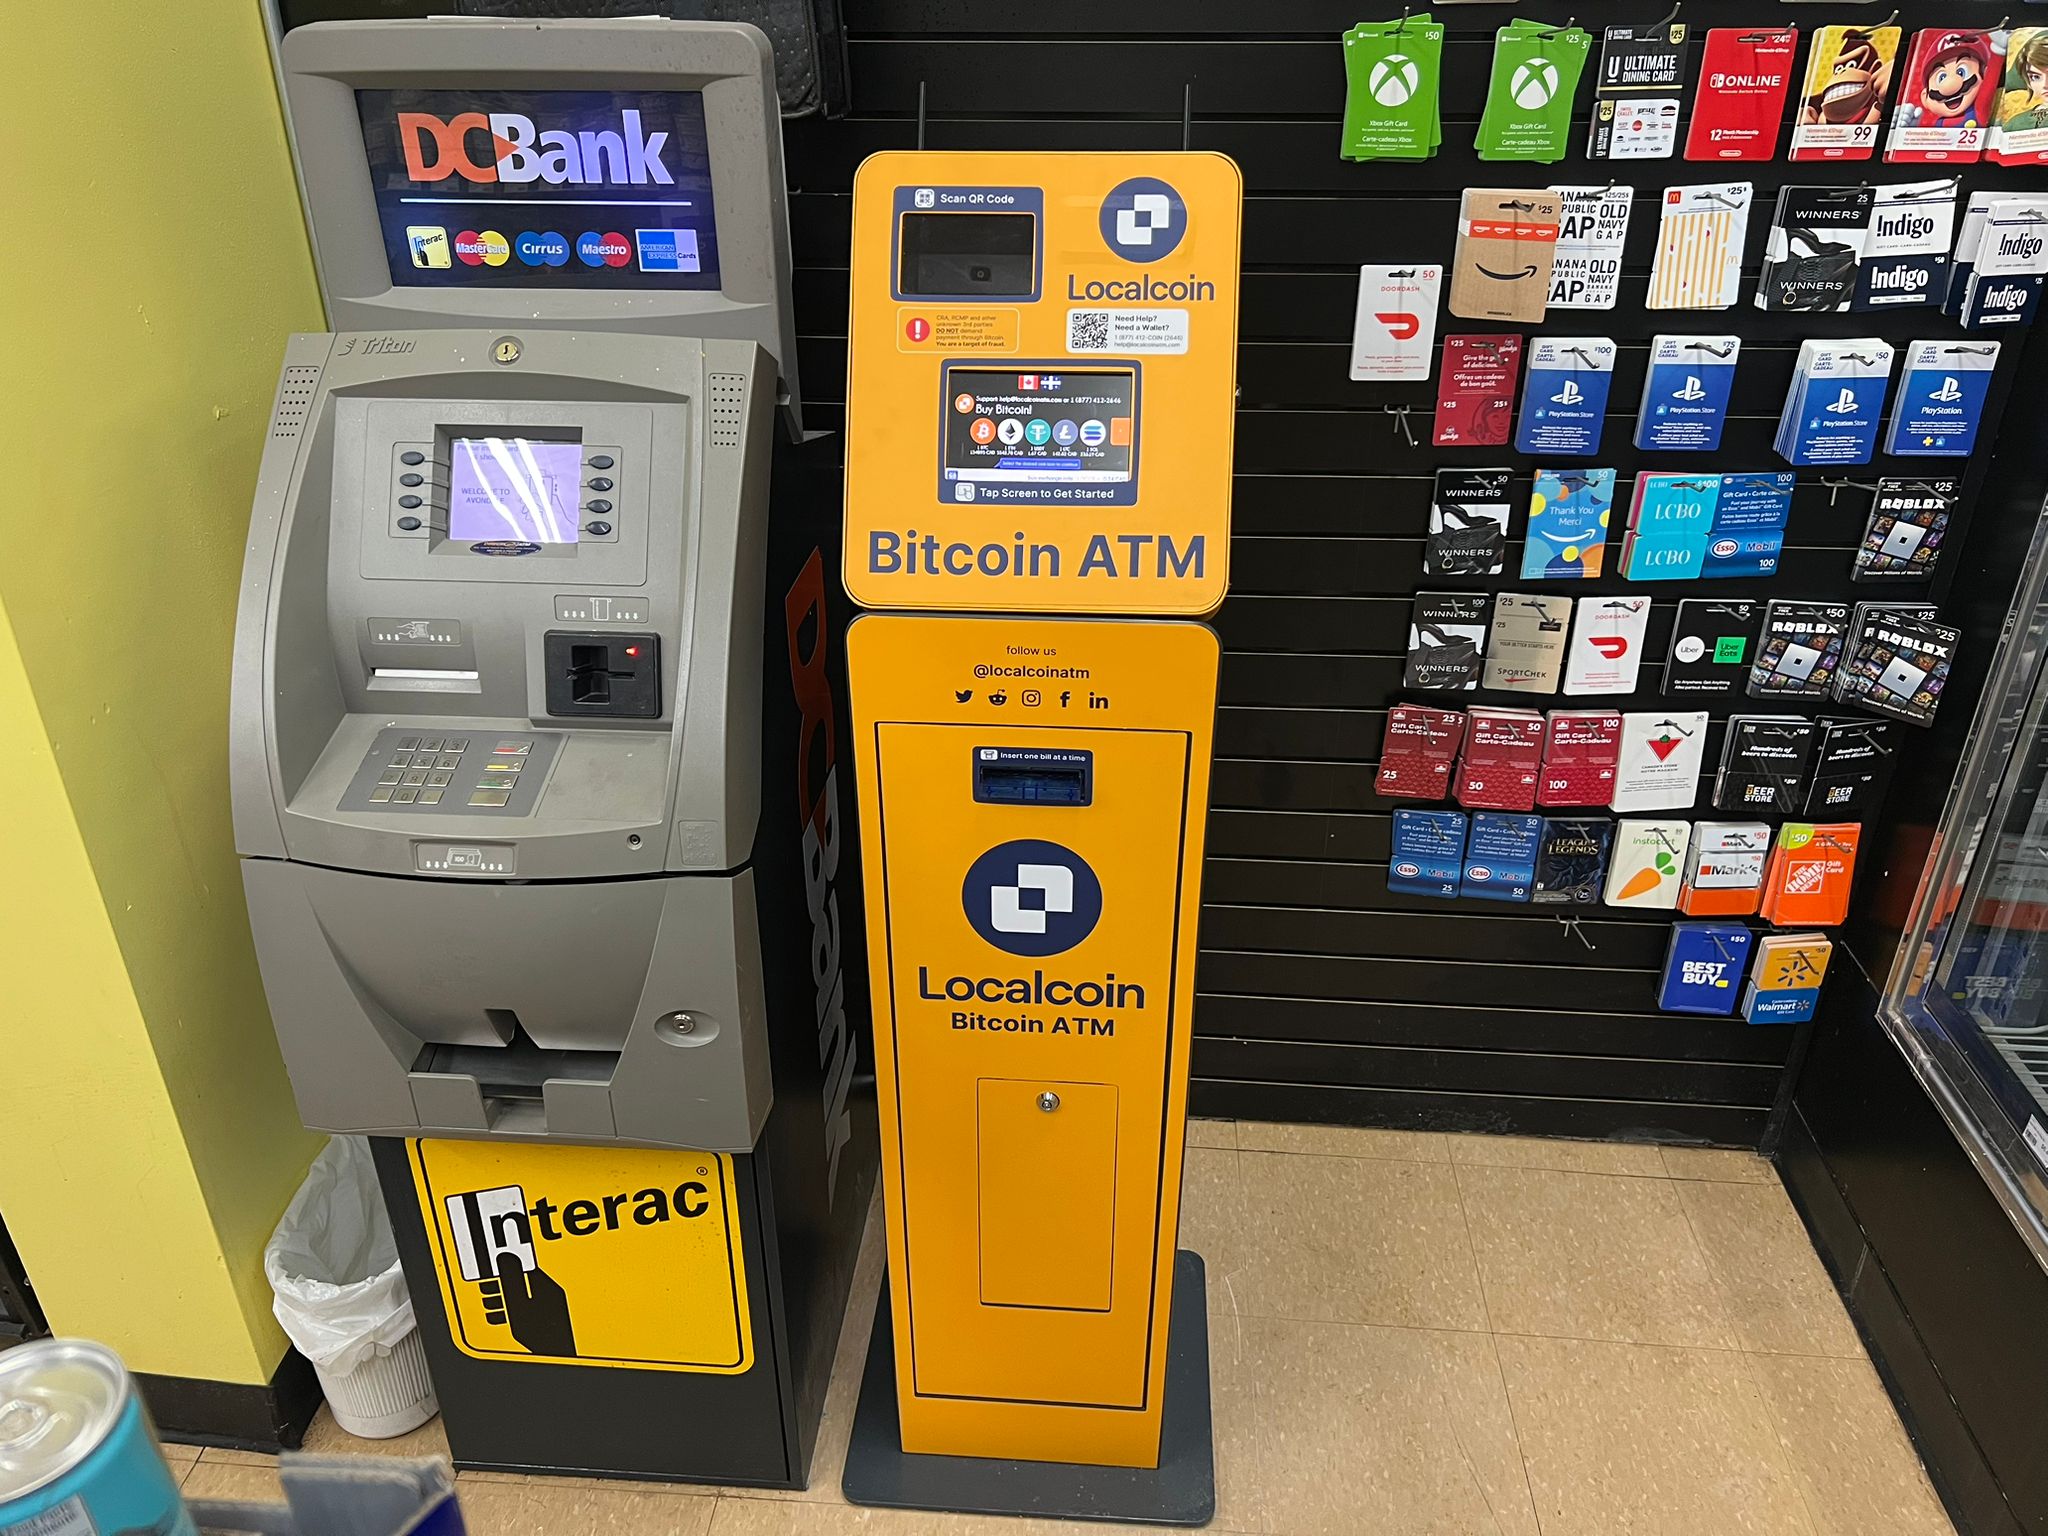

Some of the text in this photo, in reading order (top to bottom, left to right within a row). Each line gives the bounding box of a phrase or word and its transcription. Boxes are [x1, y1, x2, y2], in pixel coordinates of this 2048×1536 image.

[1425, 31, 1440, 40] $50
[1566, 34, 1580, 44] $25
[1671, 30, 1683, 40] $25
[1624, 54, 1677, 71] ULTIMATE
[1622, 69, 1677, 83] DINING CARD
[1725, 75, 1782, 87] ONLINE
[1600, 106, 1612, 115] $25
[1710, 129, 1722, 141] 12
[1854, 126, 1872, 141] 99
[1957, 129, 1978, 144] 25
[397, 109, 674, 184] DCBank
[940, 193, 1015, 205] Scan QR Code
[1857, 194, 1869, 203] 25
[1538, 205, 1553, 215] $25
[1600, 204, 1628, 219] OLD
[1795, 210, 1862, 220] WINNERS
[1597, 219, 1625, 229] NAVY
[456, 242, 507, 254] MasterCard
[522, 242, 563, 255] Cirrus
[582, 242, 626, 255] Maestro
[677, 252, 697, 260] Cards
[1589, 259, 1617, 274] OLD
[1422, 270, 1435, 279] 50
[1587, 274, 1615, 284] NAVY
[1068, 273, 1215, 301] Localcoin
[1780, 281, 1844, 291] WINNERS
[1135, 315, 1158, 323] Help?
[361, 337, 417, 355] Triton
[1451, 339, 1464, 347] $25
[1723, 340, 1736, 349] $75
[1594, 346, 1612, 354] $100
[1875, 352, 1889, 360] $50
[975, 395, 999, 403] Support
[1493, 400, 1508, 408] 25$
[975, 404, 1033, 416] Buy Bitcoin!
[1548, 410, 1580, 418] PlayStation
[1669, 406, 1701, 415] PlayStation
[1920, 406, 1963, 415] PlayStation
[1822, 419, 1854, 428] PlayStation
[1497, 474, 1509, 483] 50
[1597, 471, 1608, 479] 50
[1776, 473, 1793, 483] 100
[1934, 481, 1954, 492] $25
[979, 487, 1115, 500] Tap Screen to Get Started
[1445, 489, 1502, 497] WINNERS
[1880, 498, 1945, 510] ROBLOX
[1550, 506, 1595, 516] Thank You
[1655, 502, 1701, 520] LCBO
[1558, 517, 1583, 526] Merci
[1716, 544, 1735, 552] Esso
[1746, 541, 1776, 553] Mobil
[867, 529, 1206, 578] Bitcoin ATM
[1438, 548, 1494, 557] WINNERS
[1645, 549, 1692, 566] LCBO
[1759, 558, 1775, 567] 100
[1500, 597, 1514, 607] $25
[1826, 608, 1846, 618] $50
[1917, 611, 1936, 620] $25
[1771, 621, 1839, 635] ROBLOX
[1935, 628, 1956, 642] $25
[1877, 629, 1949, 659] ROBLOX
[1006, 645, 1057, 657] follow us
[973, 663, 1090, 679] @localcoinatm
[1415, 664, 1470, 673] WINNERS
[1442, 714, 1455, 723] 25
[1602, 719, 1619, 728] 100
[1527, 722, 1541, 731] 50
[1475, 738, 1534, 747] Carte-Cadeau
[1750, 745, 1793, 754] Hundreds of
[1000, 751, 1023, 759] Insert
[1040, 752, 1052, 760] bill
[1383, 770, 1397, 779] 25
[1468, 781, 1483, 791] 50
[1549, 780, 1568, 790] 100
[1745, 784, 1776, 796] BEER
[1828, 786, 1854, 797] BEER
[1743, 795, 1773, 803] STORE
[1825, 794, 1851, 805] STORE
[1451, 817, 1463, 825] 25
[1526, 818, 1538, 826] 50
[1753, 831, 1767, 840] $50
[1792, 833, 1808, 842] $50
[1556, 838, 1588, 846] LEAGU
[1548, 844, 1599, 855] LEGENDS
[1399, 865, 1417, 874] Esso
[1427, 868, 1455, 879] Mobil
[1471, 869, 1489, 877] Esso
[1711, 864, 1758, 875] Mark's
[1499, 871, 1527, 881] Mobil
[1787, 862, 1825, 893] HOME
[1442, 884, 1453, 892] 25
[1512, 887, 1525, 896] 50
[1730, 935, 1746, 943] $50
[1681, 960, 1726, 975] BEST
[1681, 972, 1721, 986] BUY
[918, 965, 1146, 1009] Localcoin
[1757, 1001, 1797, 1012] Walmart
[951, 1011, 1115, 1037] Bitcoin ATM
[462, 1181, 710, 1278] Interac
